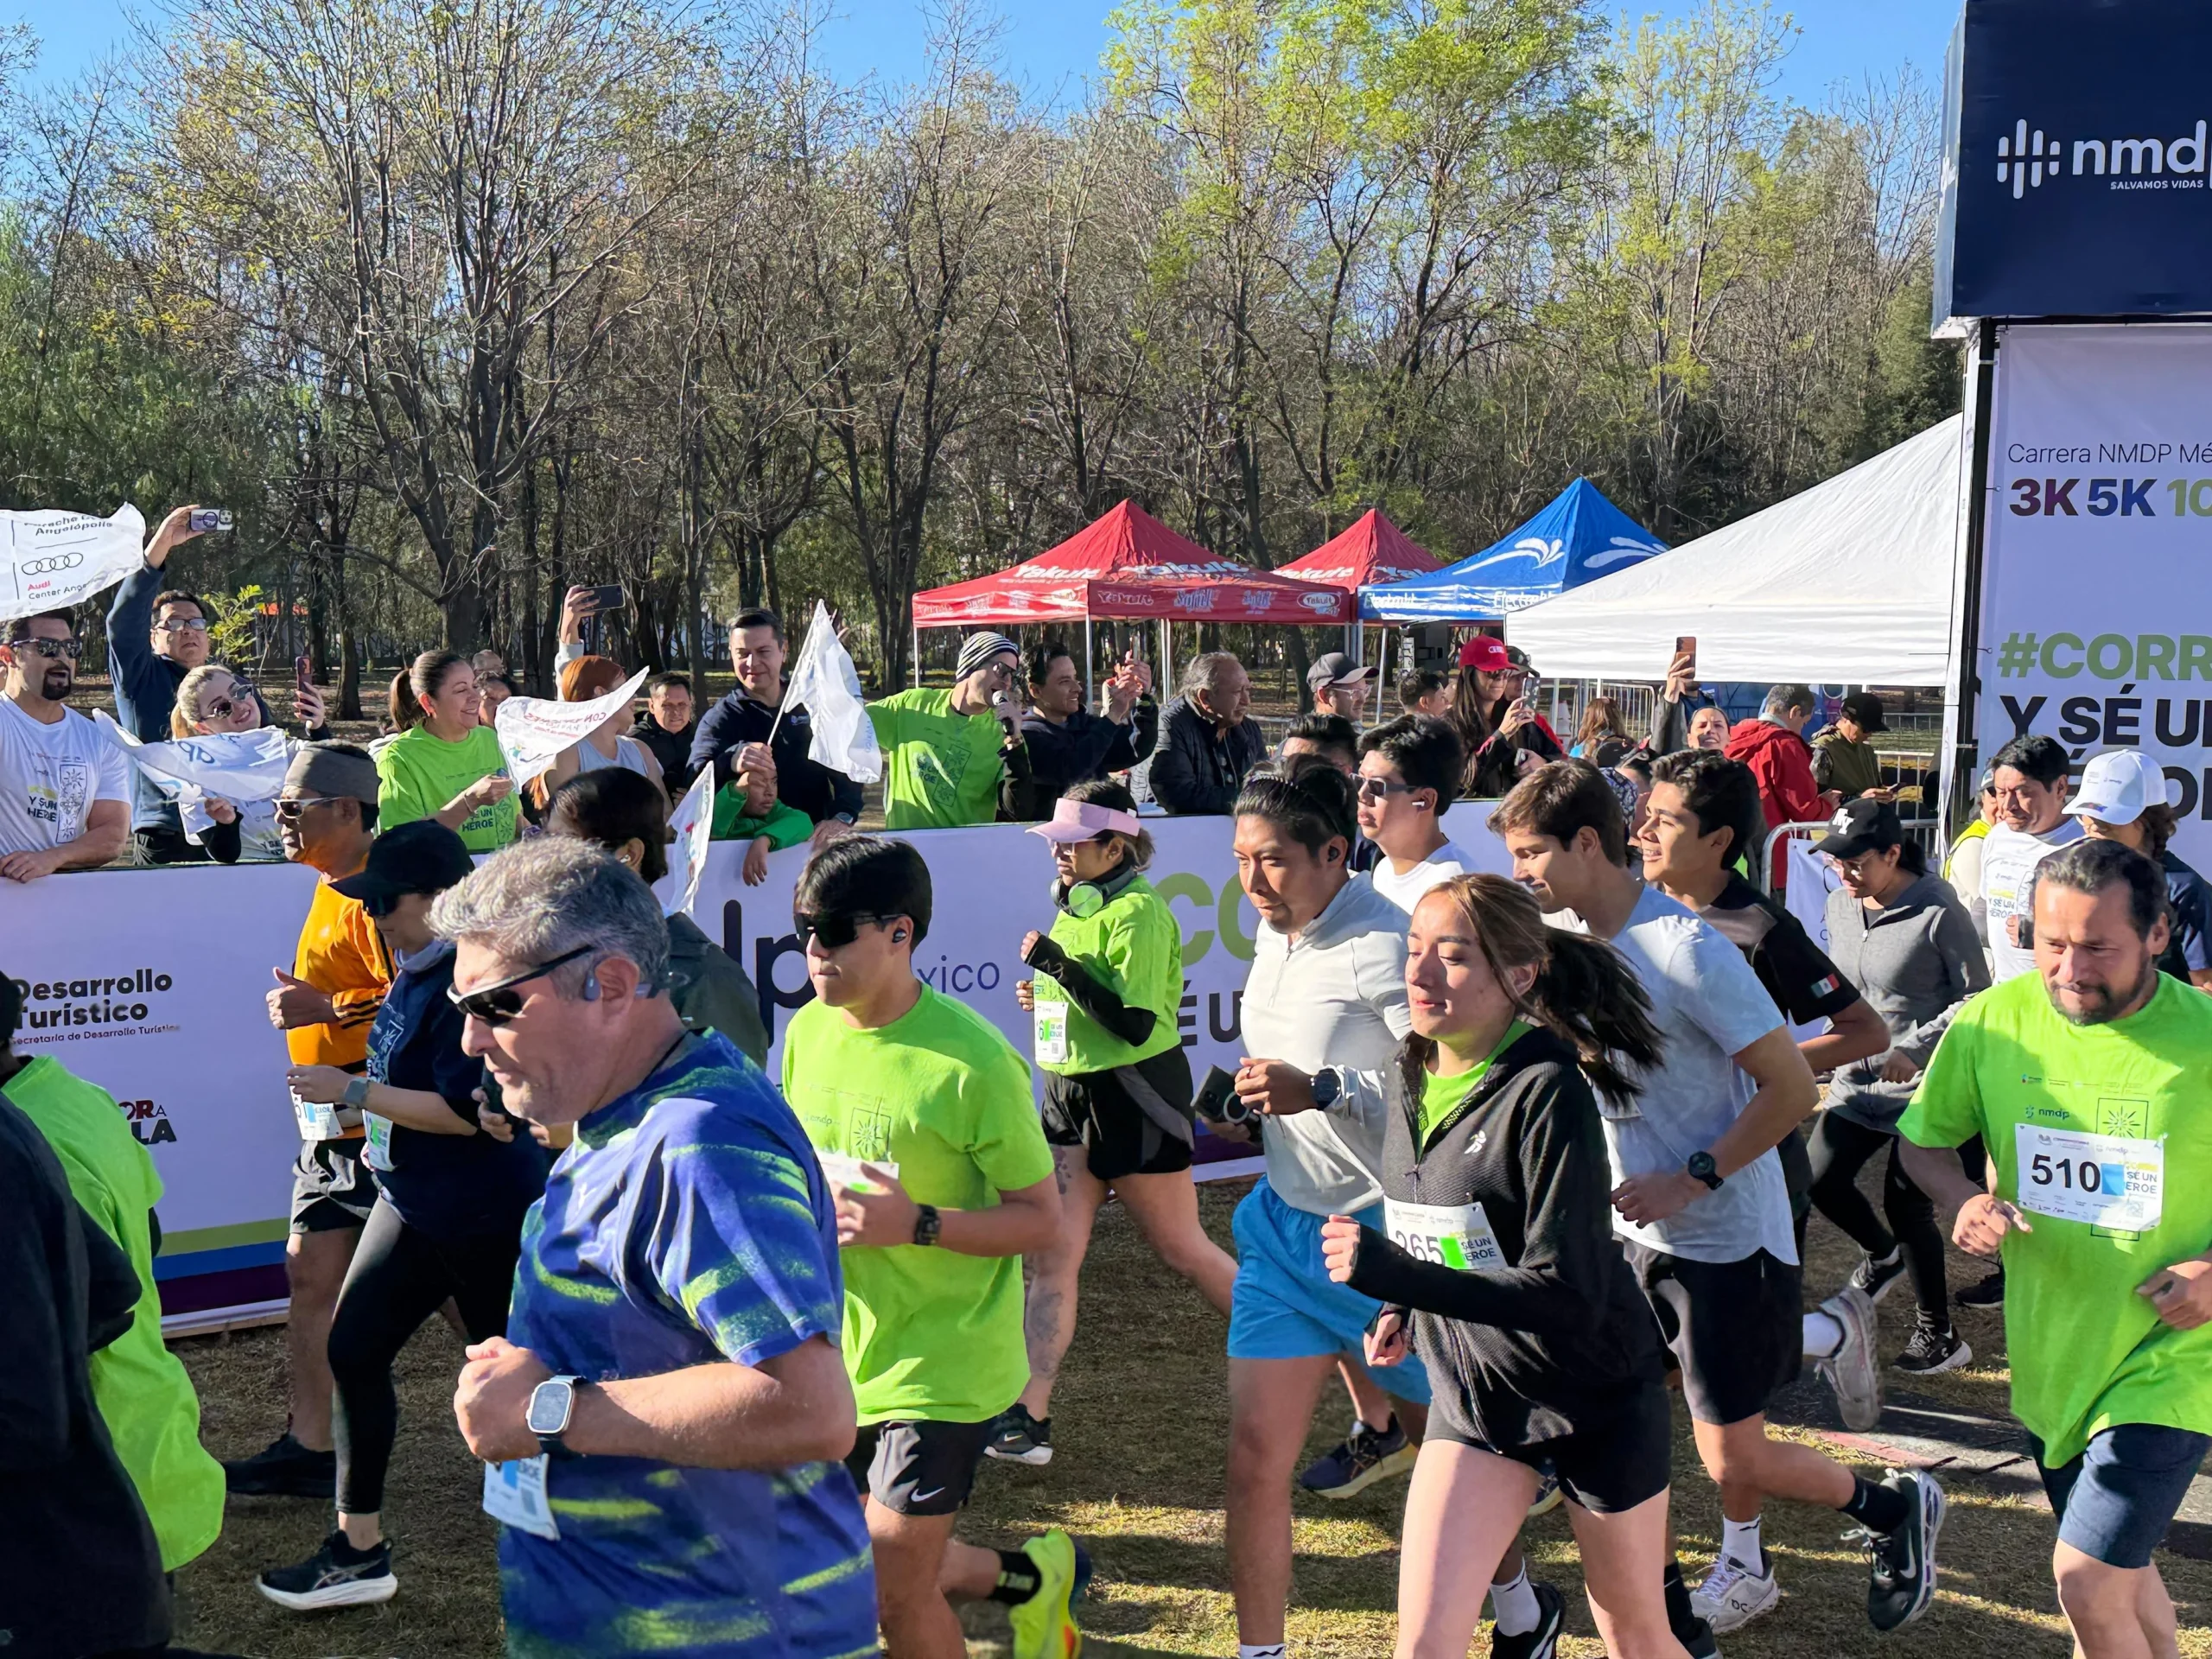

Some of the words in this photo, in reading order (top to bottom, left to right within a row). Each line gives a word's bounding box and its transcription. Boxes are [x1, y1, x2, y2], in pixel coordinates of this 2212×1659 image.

[2073, 119, 2212, 189] nmd
[2110, 180, 2168, 190] SALVAMOS
[2171, 180, 2204, 188] VIDAS
[2008, 443, 2091, 463] Carrera
[2099, 443, 2172, 464] NMDP
[2179, 442, 2212, 463] Mé
[2009, 478, 2080, 516] 3K
[2087, 479, 2158, 517] 5K
[2167, 479, 2212, 517] 10
[1014, 565, 1100, 579] Yakult
[28, 581, 51, 591] Audi
[29, 589, 61, 600] Center
[64, 581, 87, 593] Ange
[1997, 632, 2212, 681] #CORR
[2058, 683, 2142, 746] SÉ
[2155, 699, 2212, 747] U
[1832, 808, 1855, 835] NY
[917, 955, 1000, 993] xico
[67, 1032, 81, 1041] de
[84, 1027, 137, 1039] Desarrollo
[2031, 1154, 2101, 1193] 510
[2142, 1173, 2158, 1183] UN
[1476, 1236, 1492, 1249] UN
